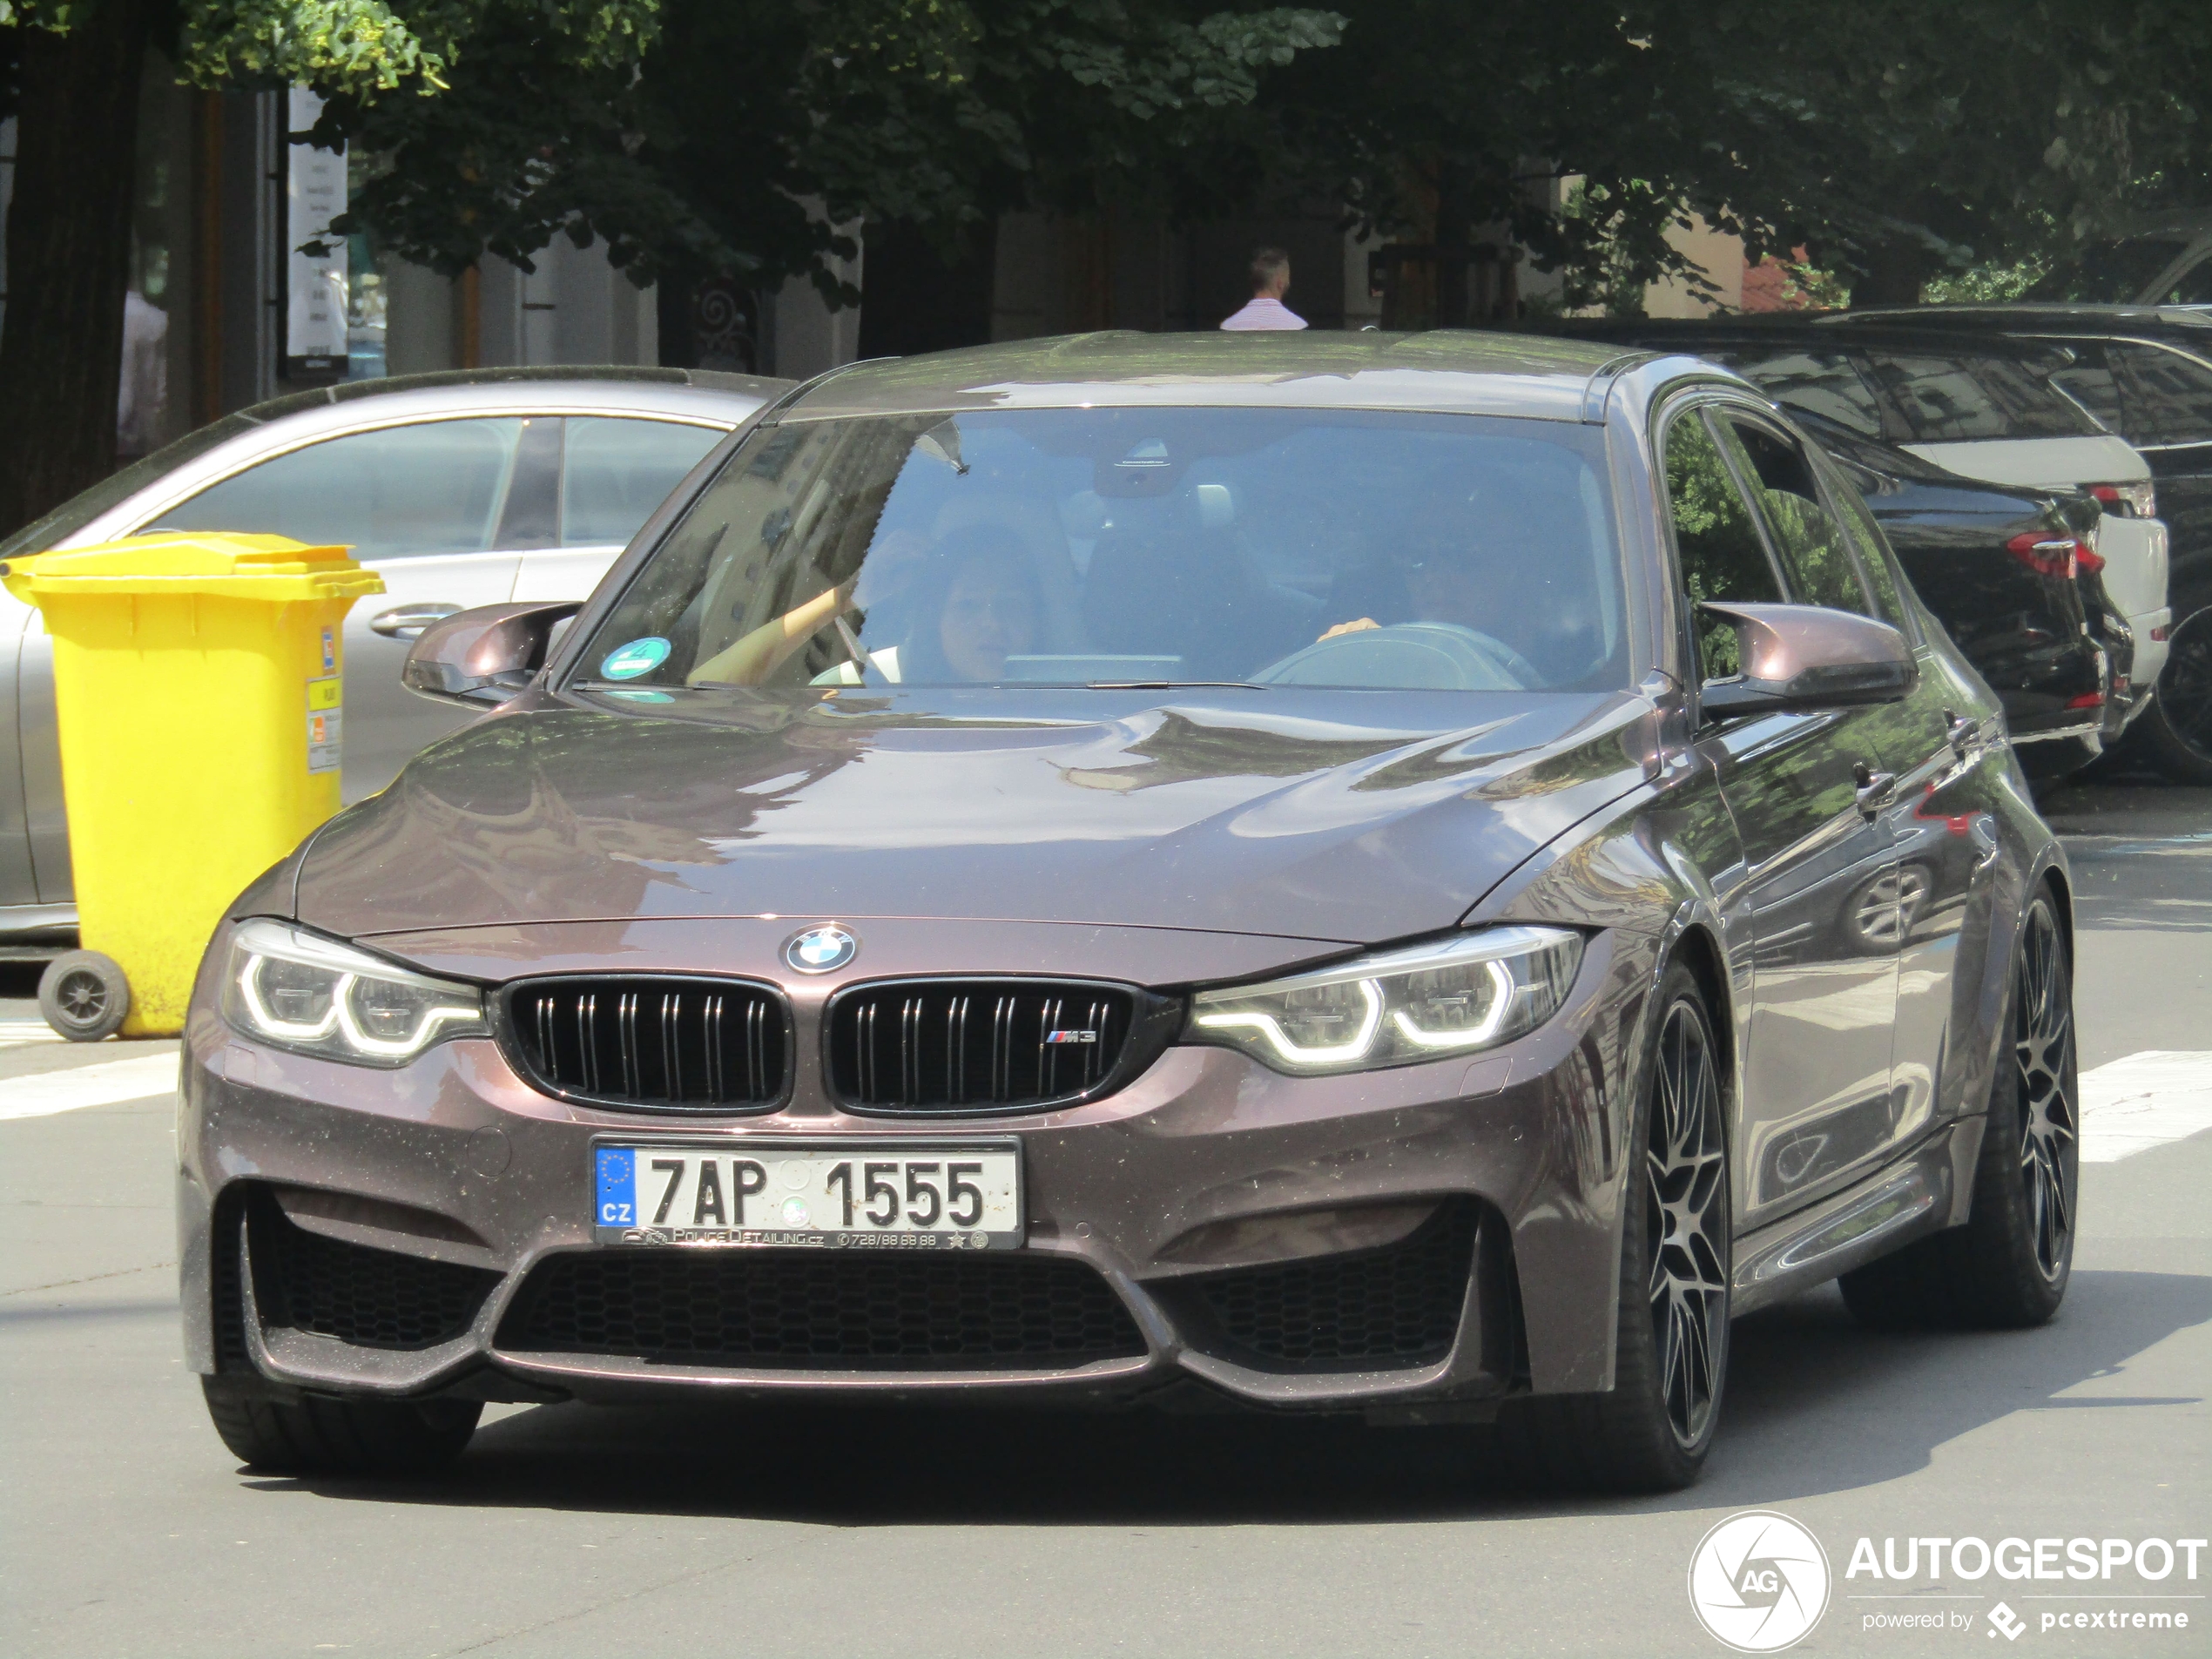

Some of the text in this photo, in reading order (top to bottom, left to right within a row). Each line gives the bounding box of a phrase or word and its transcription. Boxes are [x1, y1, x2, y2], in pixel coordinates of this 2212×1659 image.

[631, 643, 650, 658] 4
[651, 1159, 983, 1226] 7AP 1555
[603, 1203, 631, 1222] CZ
[852, 1233, 898, 1246] 728/88
[920, 1234, 936, 1246] 88
